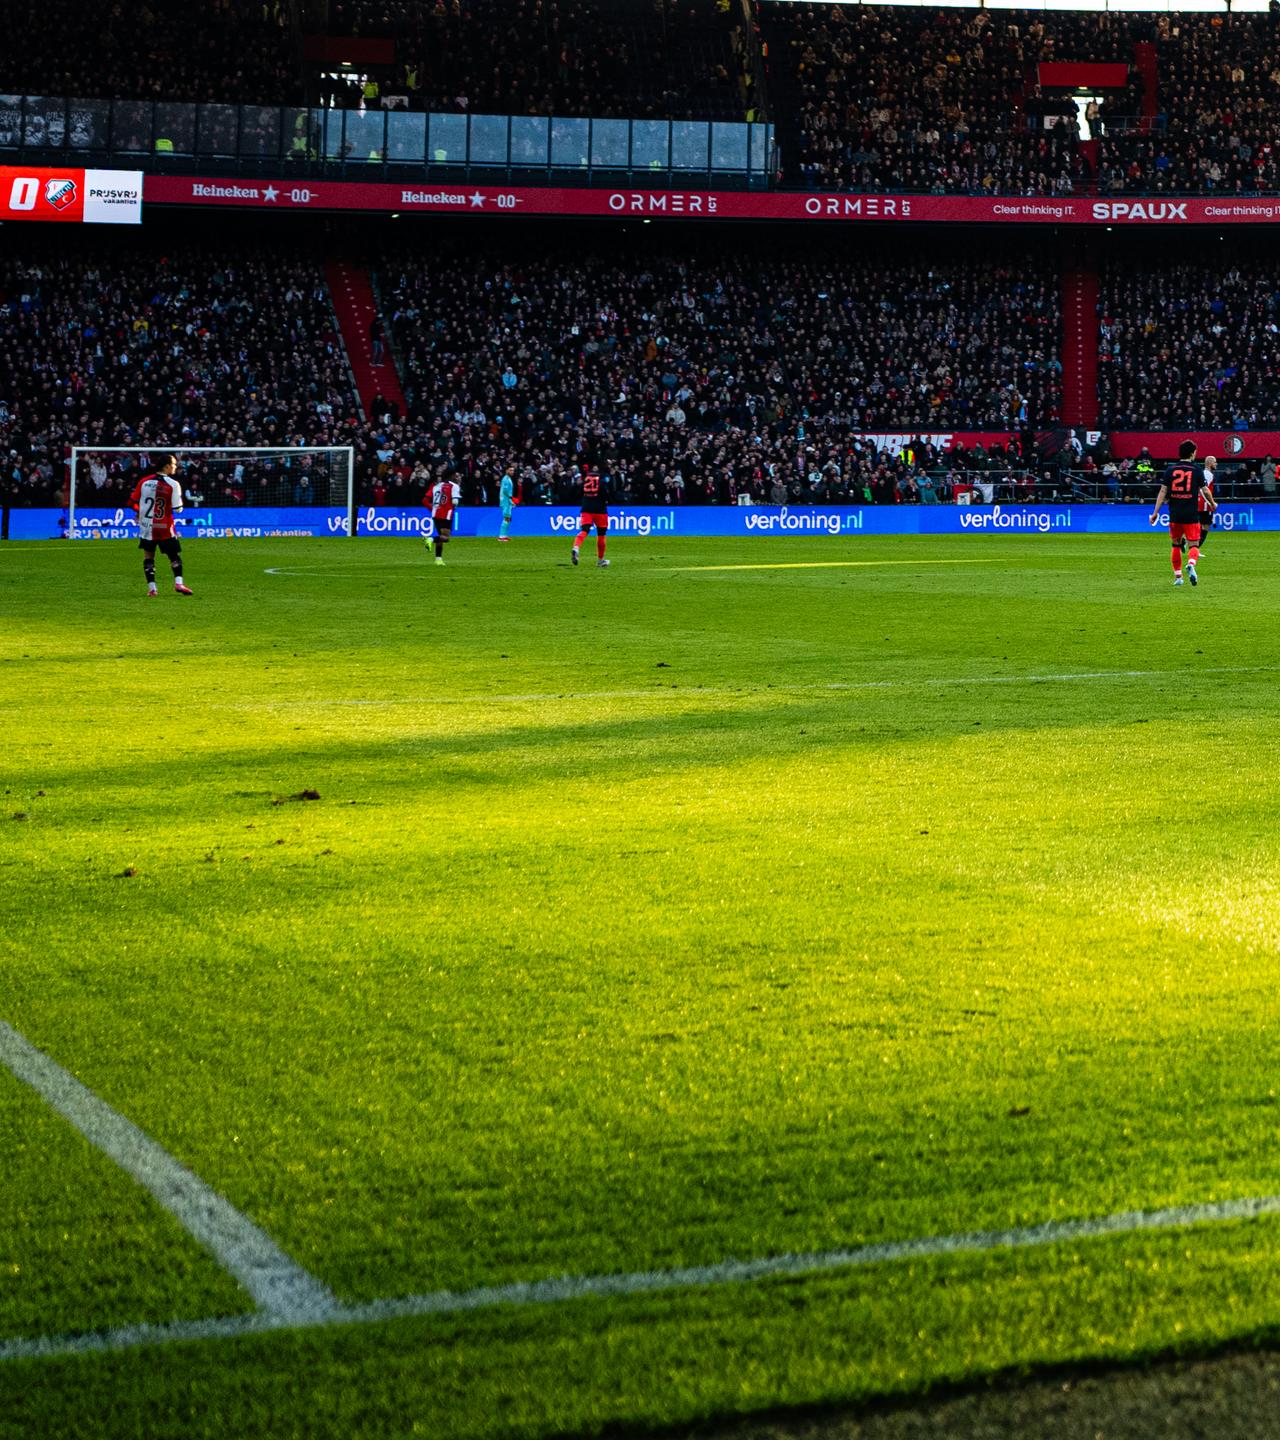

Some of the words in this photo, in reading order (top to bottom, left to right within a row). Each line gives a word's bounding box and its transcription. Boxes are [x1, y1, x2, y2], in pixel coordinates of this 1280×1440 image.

[9, 177, 40, 210] 0
[192, 184, 259, 198] Heineken
[401, 191, 466, 205] Heineken
[609, 193, 703, 212] ORMER
[805, 198, 900, 216] ORMER
[993, 204, 1021, 215] Clear
[1022, 205, 1062, 217] thinking
[1064, 206, 1076, 215] IT.
[1092, 203, 1188, 220] SPAUX
[1204, 206, 1232, 215] Clear
[1233, 205, 1272, 217] thinking
[584, 476, 600, 492] 20
[1172, 470, 1193, 491] 21
[145, 497, 165, 520] 23
[550, 510, 674, 535] verning.nl
[745, 507, 862, 534] verloning.nl
[960, 505, 1071, 531] verloning.nl
[198, 528, 261, 538] PRIJSVRIJ
[264, 529, 312, 537] vakanties
